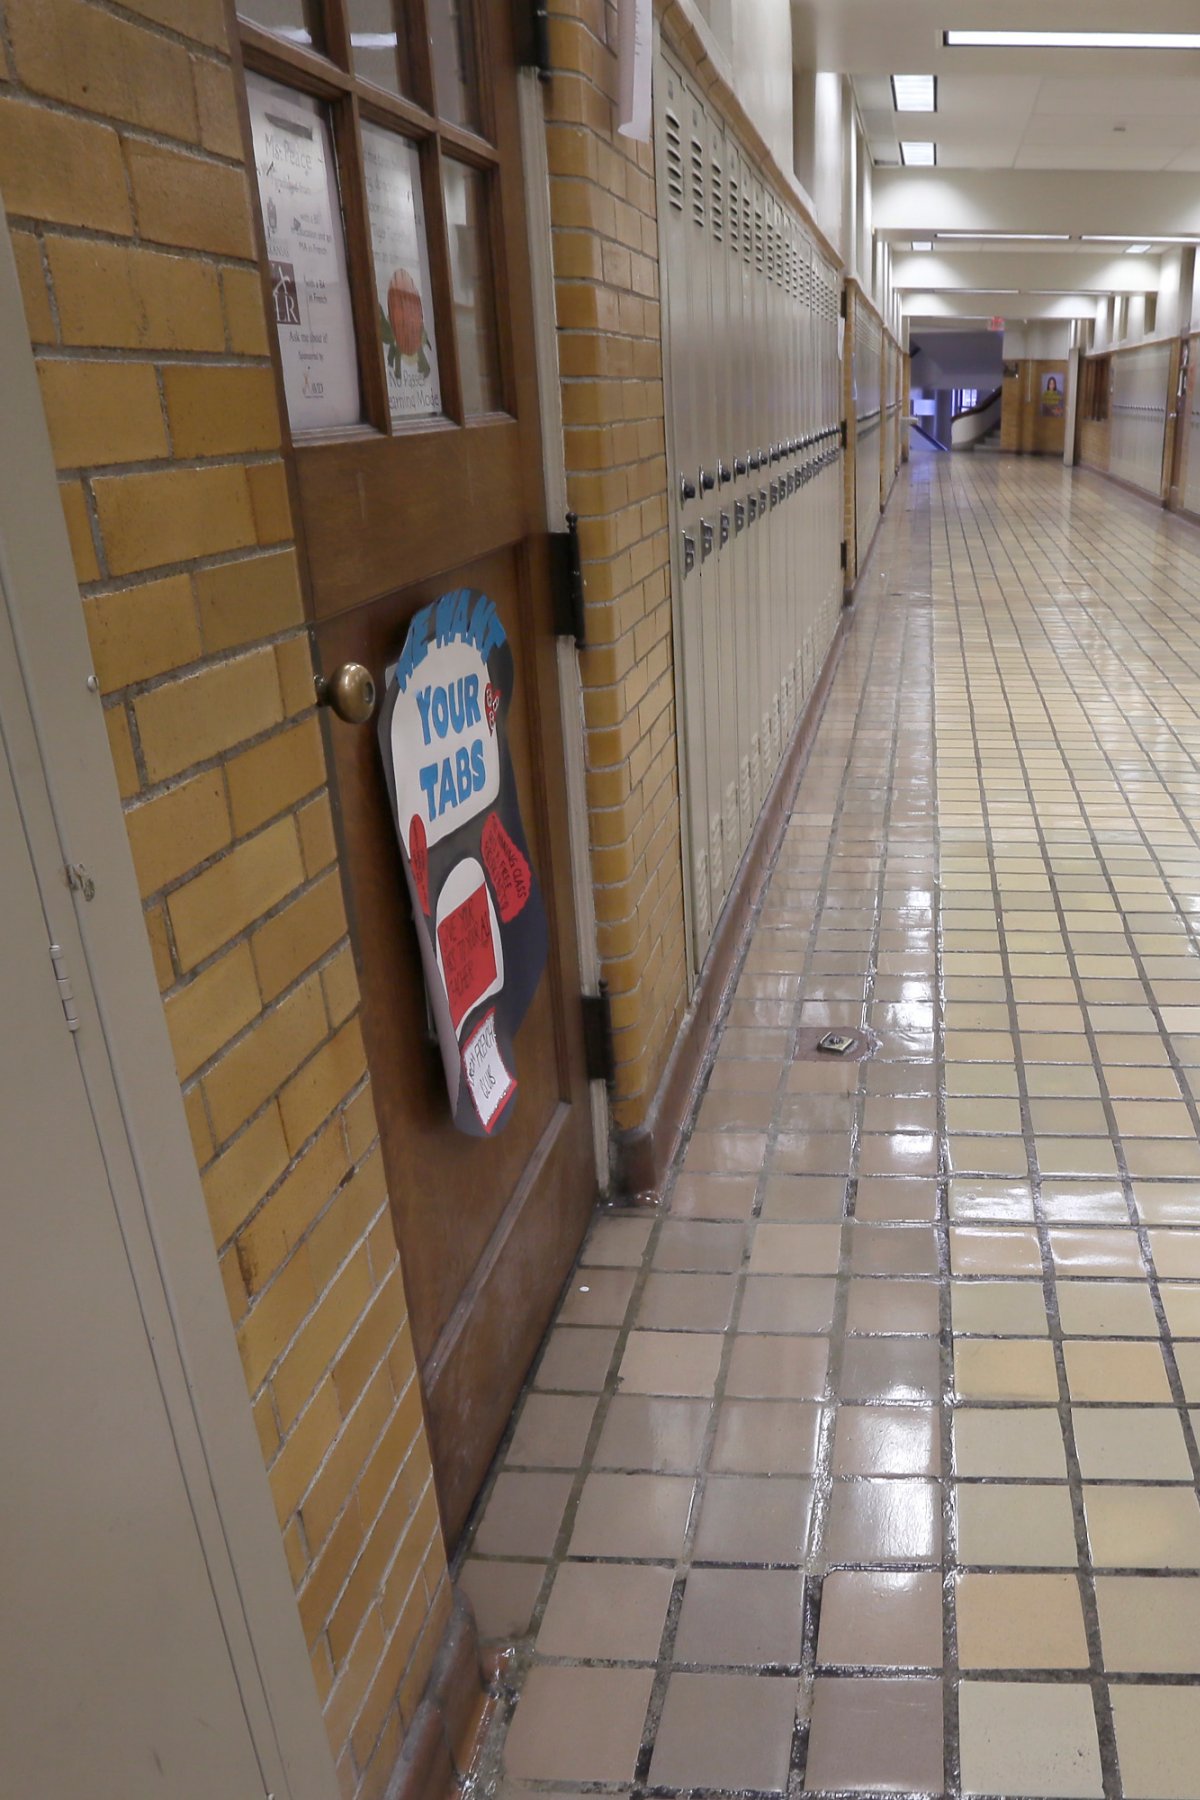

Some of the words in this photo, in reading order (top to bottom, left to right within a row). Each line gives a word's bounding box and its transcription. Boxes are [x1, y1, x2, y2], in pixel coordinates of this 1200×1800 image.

[284, 140, 312, 170] Peace
[289, 330, 300, 343] Ask
[301, 333, 310, 343] me
[417, 387, 440, 408] Mode
[395, 602, 433, 694] WE
[435, 588, 507, 666] WANT
[415, 672, 482, 746] YOUR
[418, 738, 487, 823] TABS
[512, 868, 527, 898] CLASS
[474, 1024, 496, 1068] FRENCH
[479, 1064, 497, 1099] CLUB
